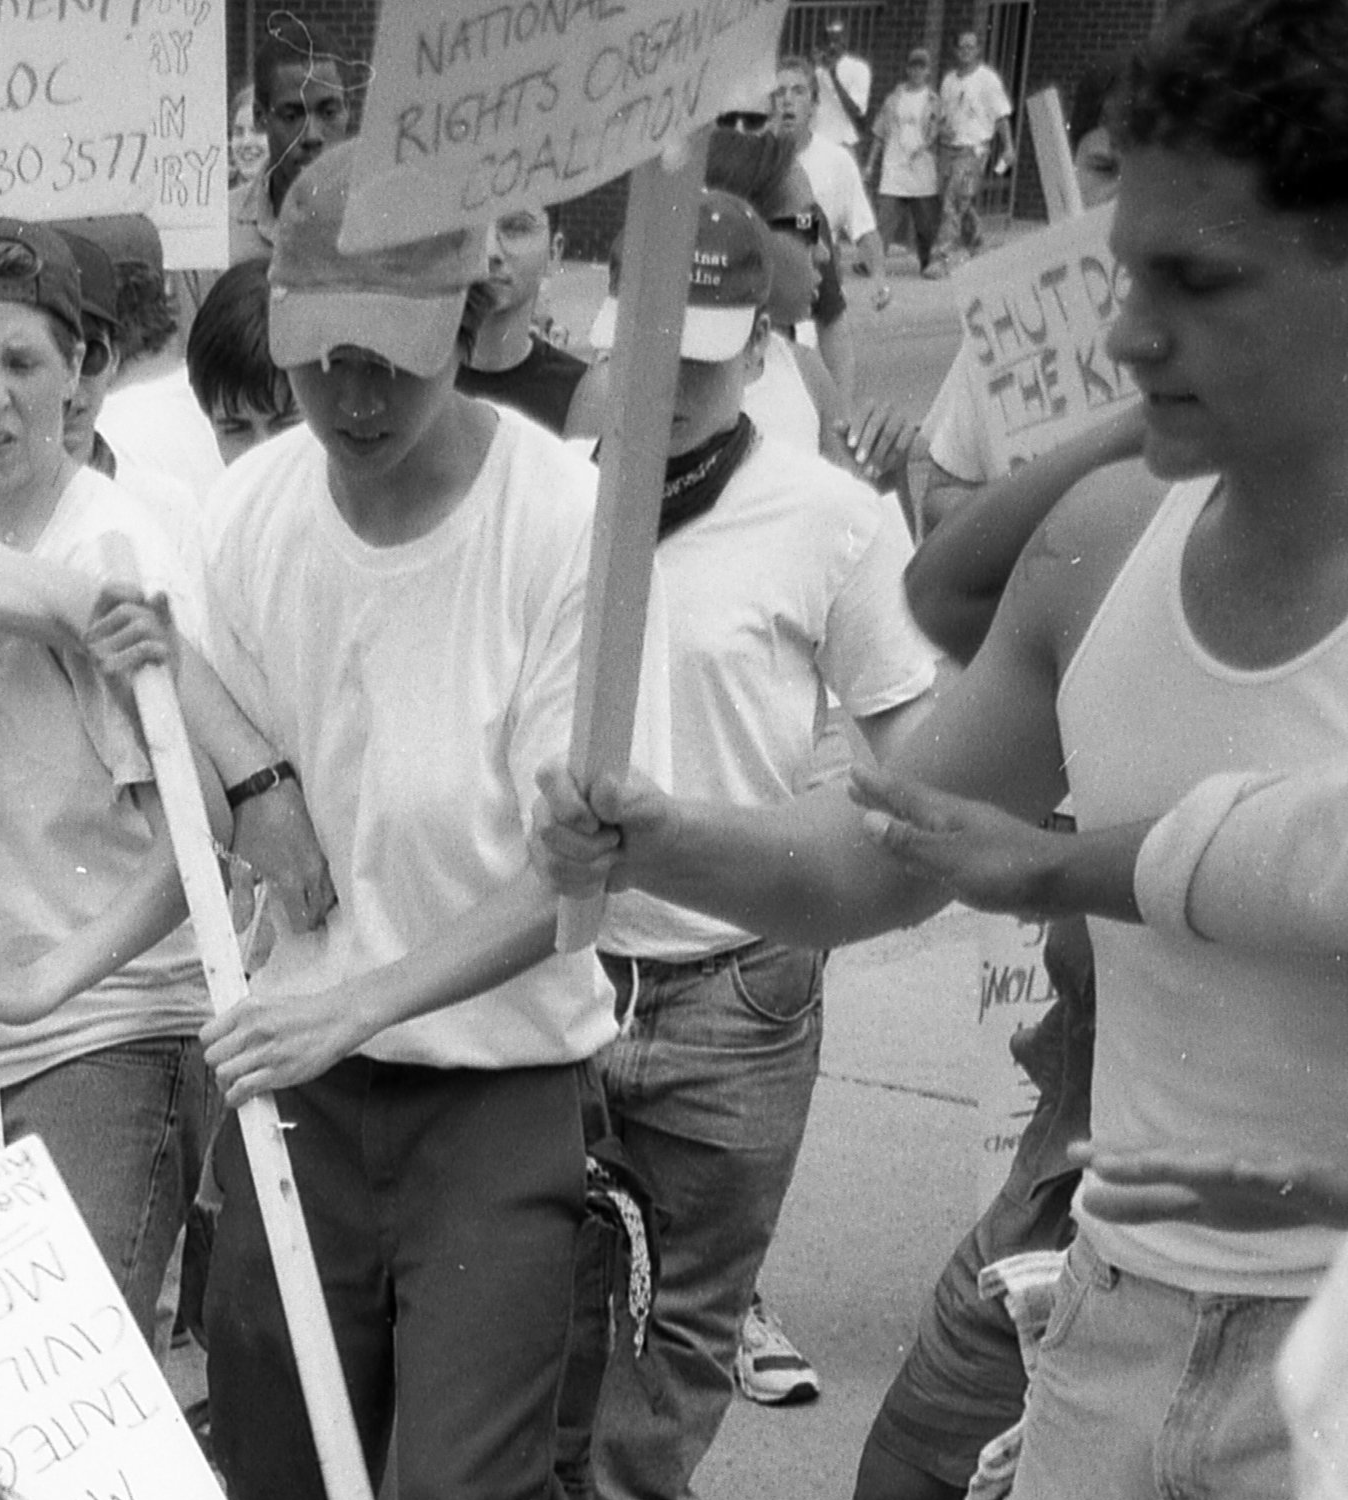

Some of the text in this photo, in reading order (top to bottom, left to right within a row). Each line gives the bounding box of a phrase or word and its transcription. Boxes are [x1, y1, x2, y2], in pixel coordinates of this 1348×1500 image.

[395, 62, 561, 165] RIGHTS
[460, 57, 709, 212] COALITION
[964, 263, 1069, 367] SHUT
[987, 348, 1068, 426] THE
